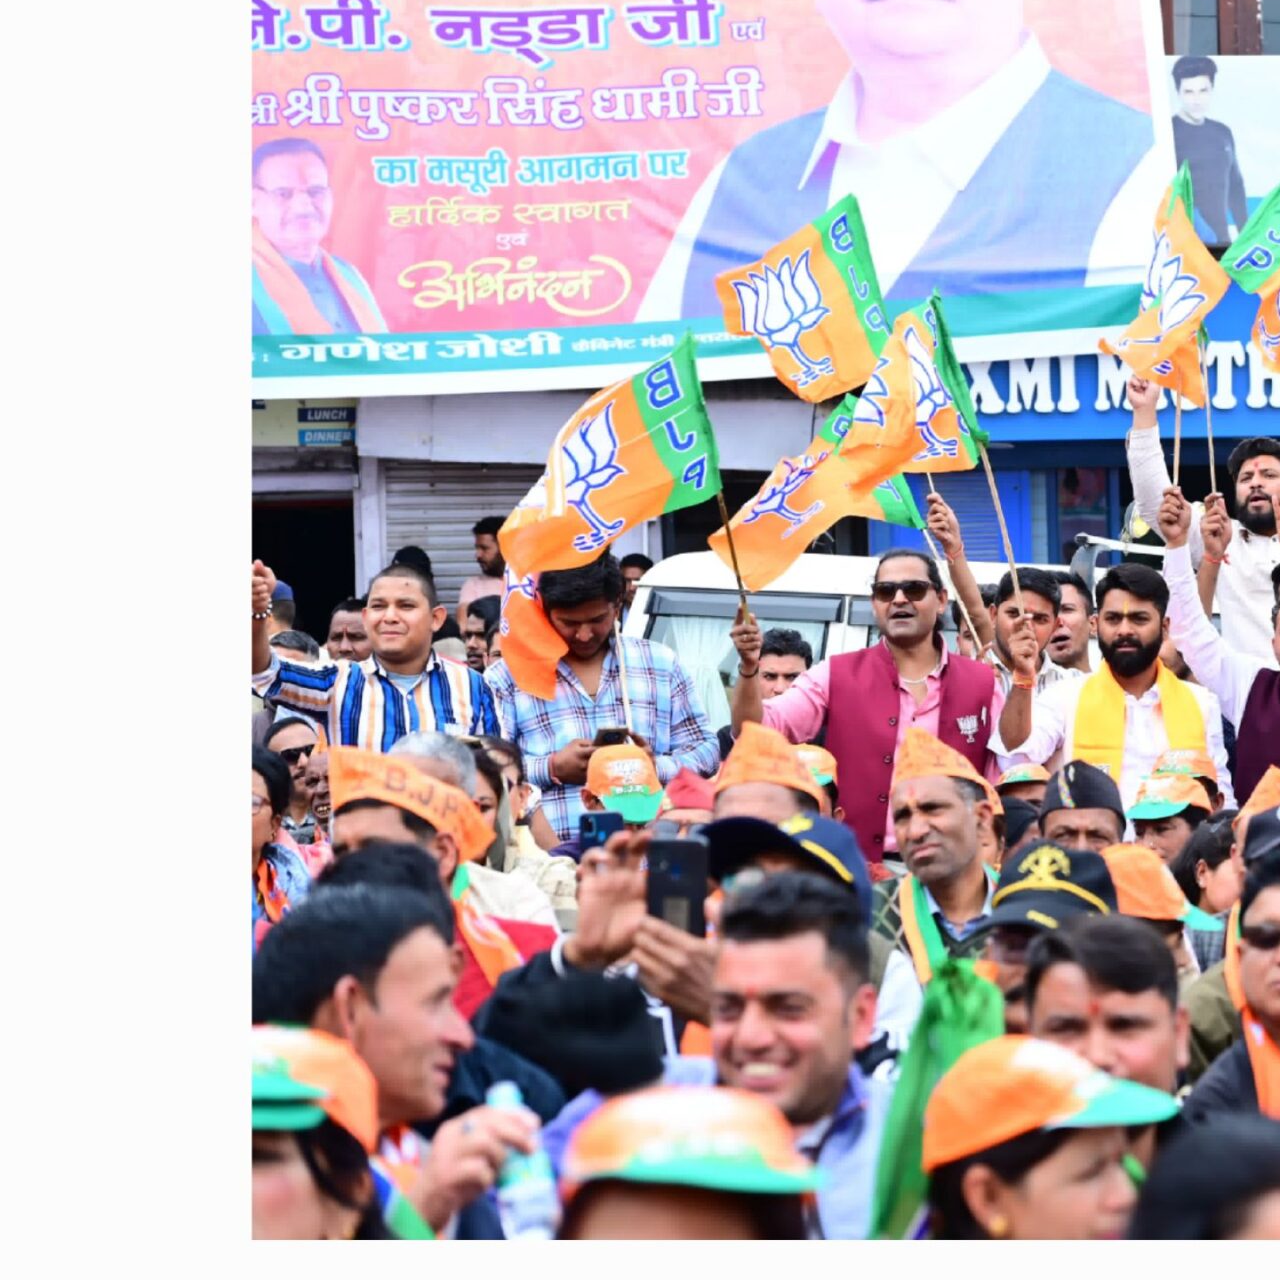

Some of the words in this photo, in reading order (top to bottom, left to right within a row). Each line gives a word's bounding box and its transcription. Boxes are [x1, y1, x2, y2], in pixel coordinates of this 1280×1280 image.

[282, 72, 344, 127] श्री
[347, 89, 481, 140] पुष्कर
[482, 76, 585, 131] सिंह
[591, 67, 700, 121] धामी
[702, 66, 765, 117] जी
[373, 157, 418, 185] का
[426, 149, 508, 194] मसूरी
[517, 152, 639, 185] आगमन
[647, 150, 690, 178] पर
[387, 196, 503, 227] हार्दिक
[513, 199, 632, 225] स्वागत
[397, 255, 632, 317] अभिनंदन
[279, 336, 429, 363] गणेश
[434, 330, 563, 359] जोशी
[966, 354, 1080, 415] XMI
[307, 409, 348, 421] LUNCH
[304, 431, 353, 443] DINNER
